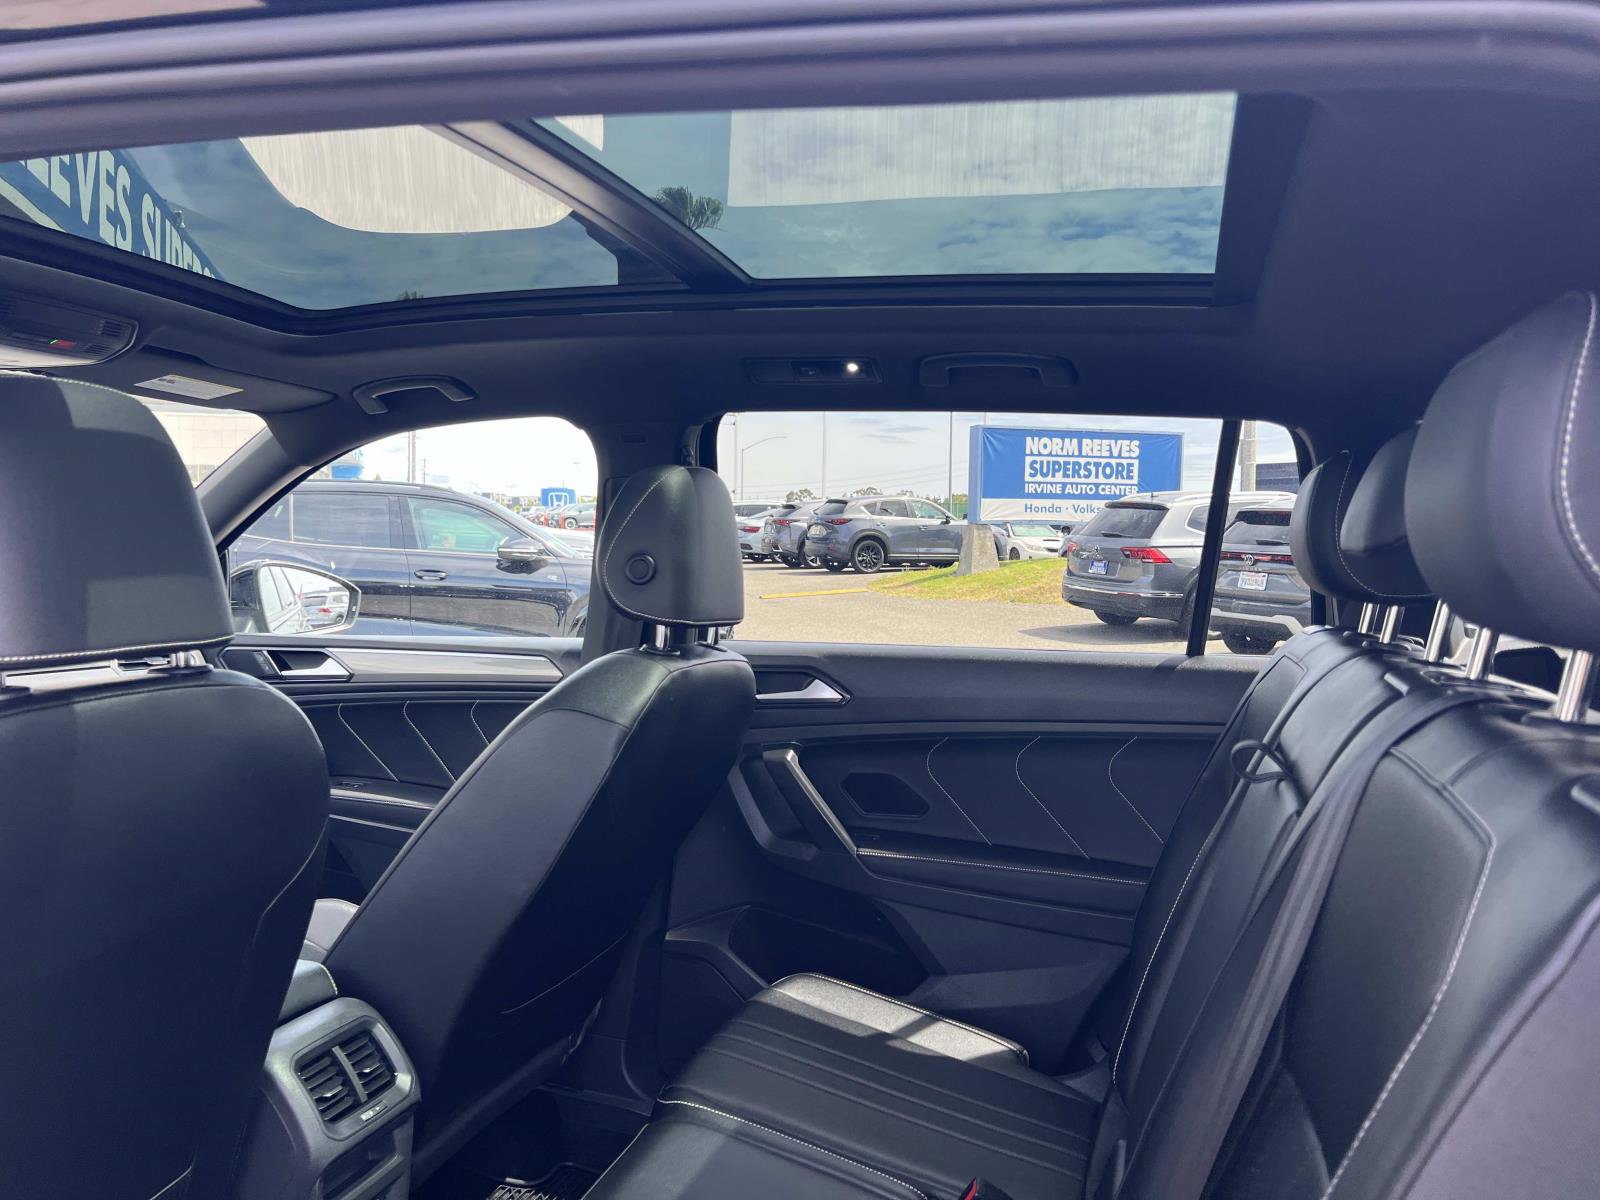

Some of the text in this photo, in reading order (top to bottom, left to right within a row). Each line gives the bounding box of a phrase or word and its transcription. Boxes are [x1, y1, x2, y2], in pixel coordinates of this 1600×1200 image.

[1025, 436, 1140, 458] NORM REEVES
[1029, 460, 1134, 480] SUPERSTORE
[1025, 483, 1139, 496] IRVINE AUTO CENTER
[1024, 503, 1062, 513] Honda
